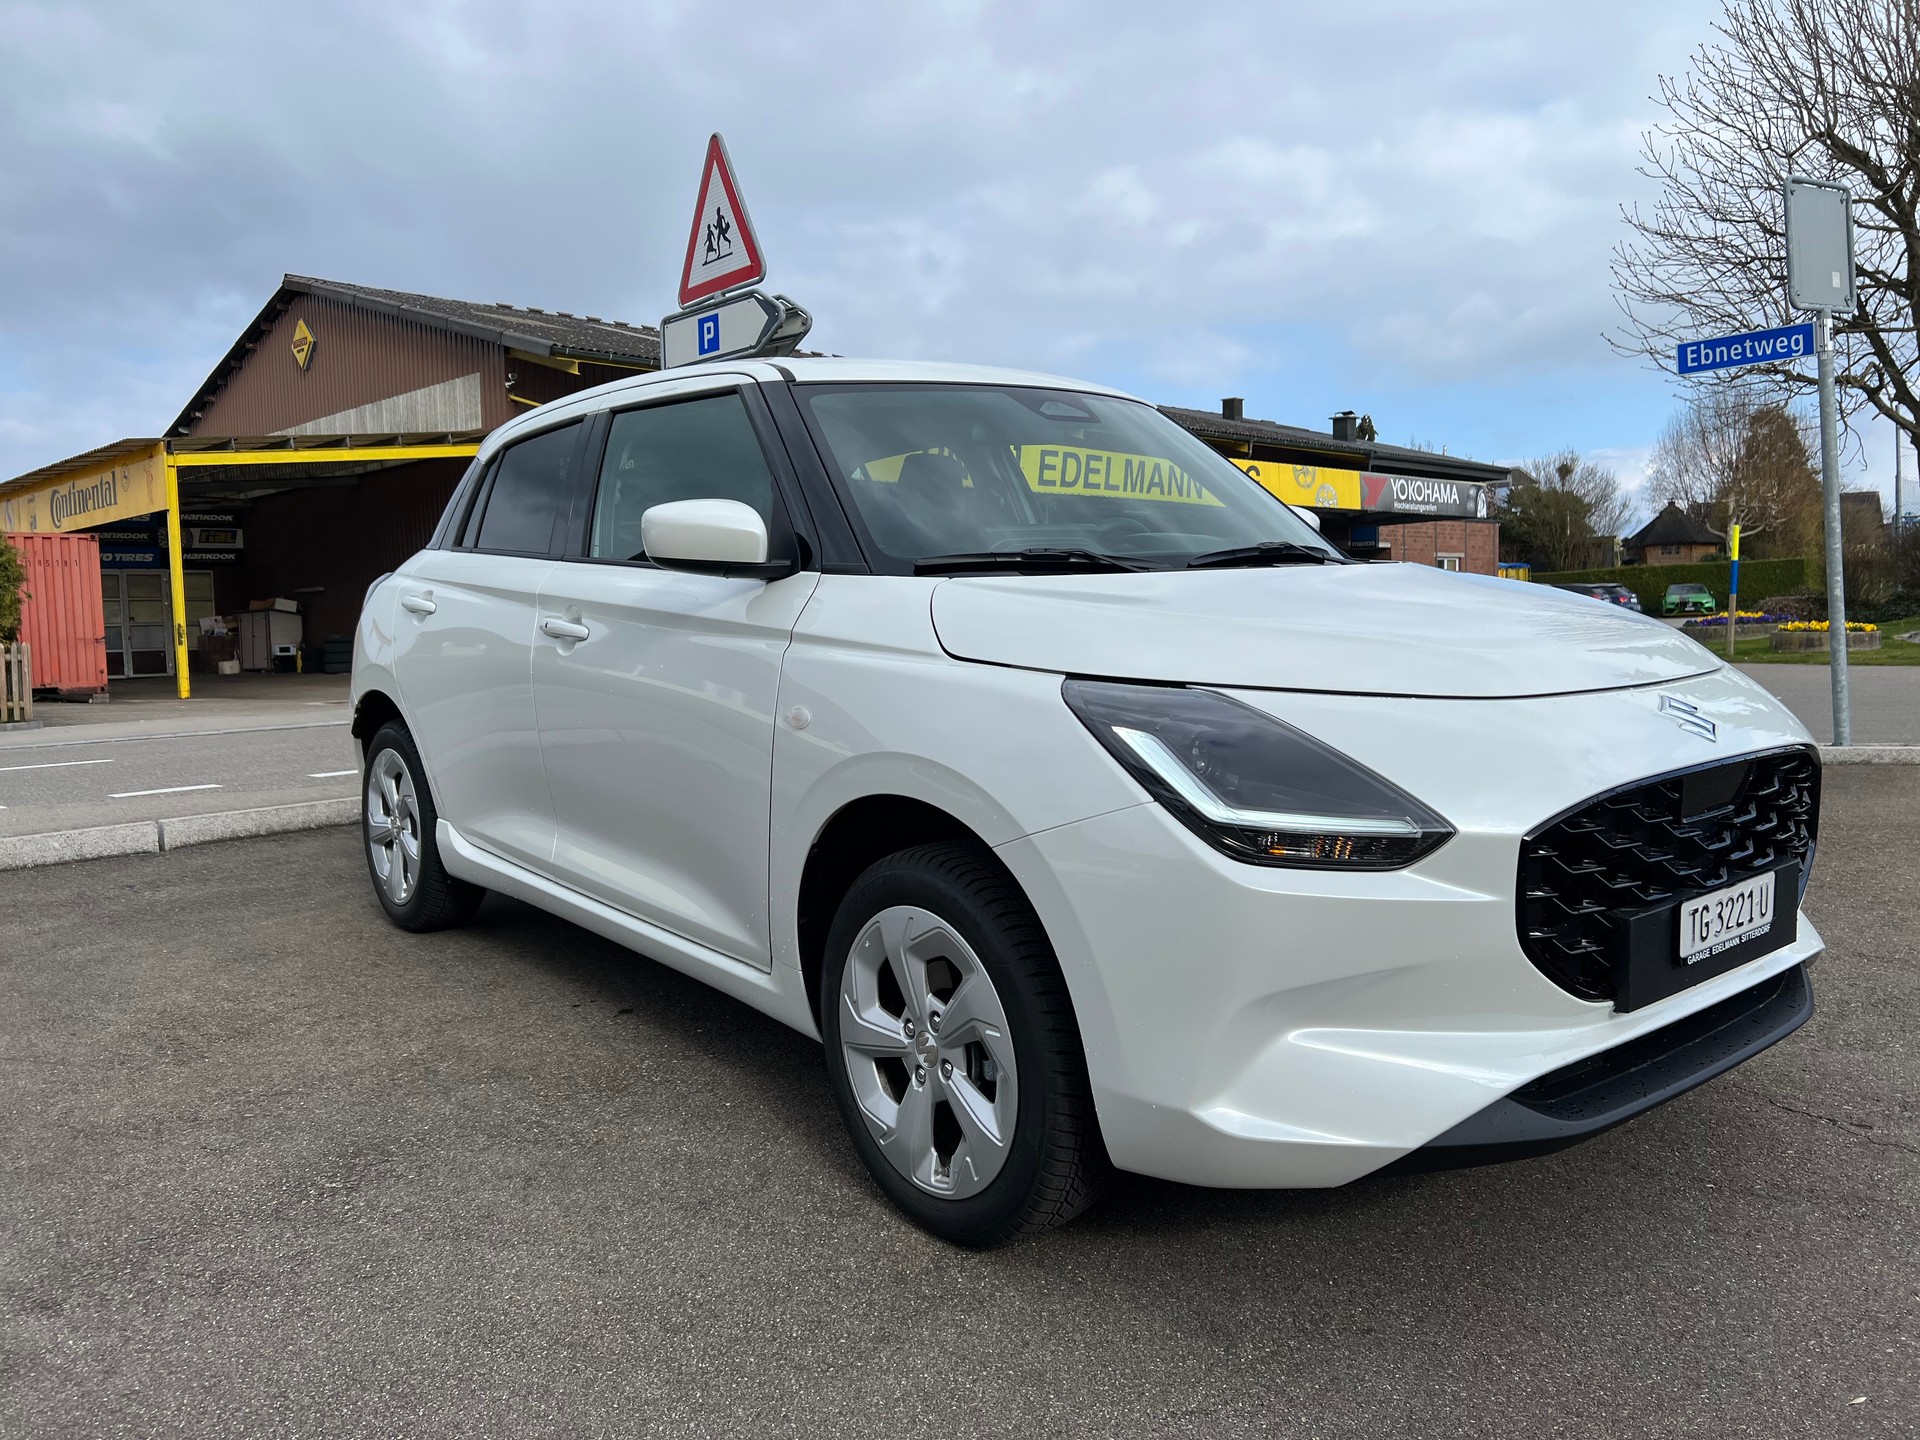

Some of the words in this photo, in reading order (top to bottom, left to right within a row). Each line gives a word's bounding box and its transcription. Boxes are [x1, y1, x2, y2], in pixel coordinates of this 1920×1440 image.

[703, 321, 715, 349] P
[1686, 333, 1805, 368] Ebnetweg
[1037, 449, 1203, 500] EDELMANN
[1390, 478, 1460, 505] YOKOHAMA
[50, 470, 118, 529] Continental
[114, 553, 154, 562] TIRES
[1687, 948, 1711, 965] GARAGE
[1712, 936, 1740, 955] EDELMANN
[1741, 923, 1771, 943] SITTERDORF
